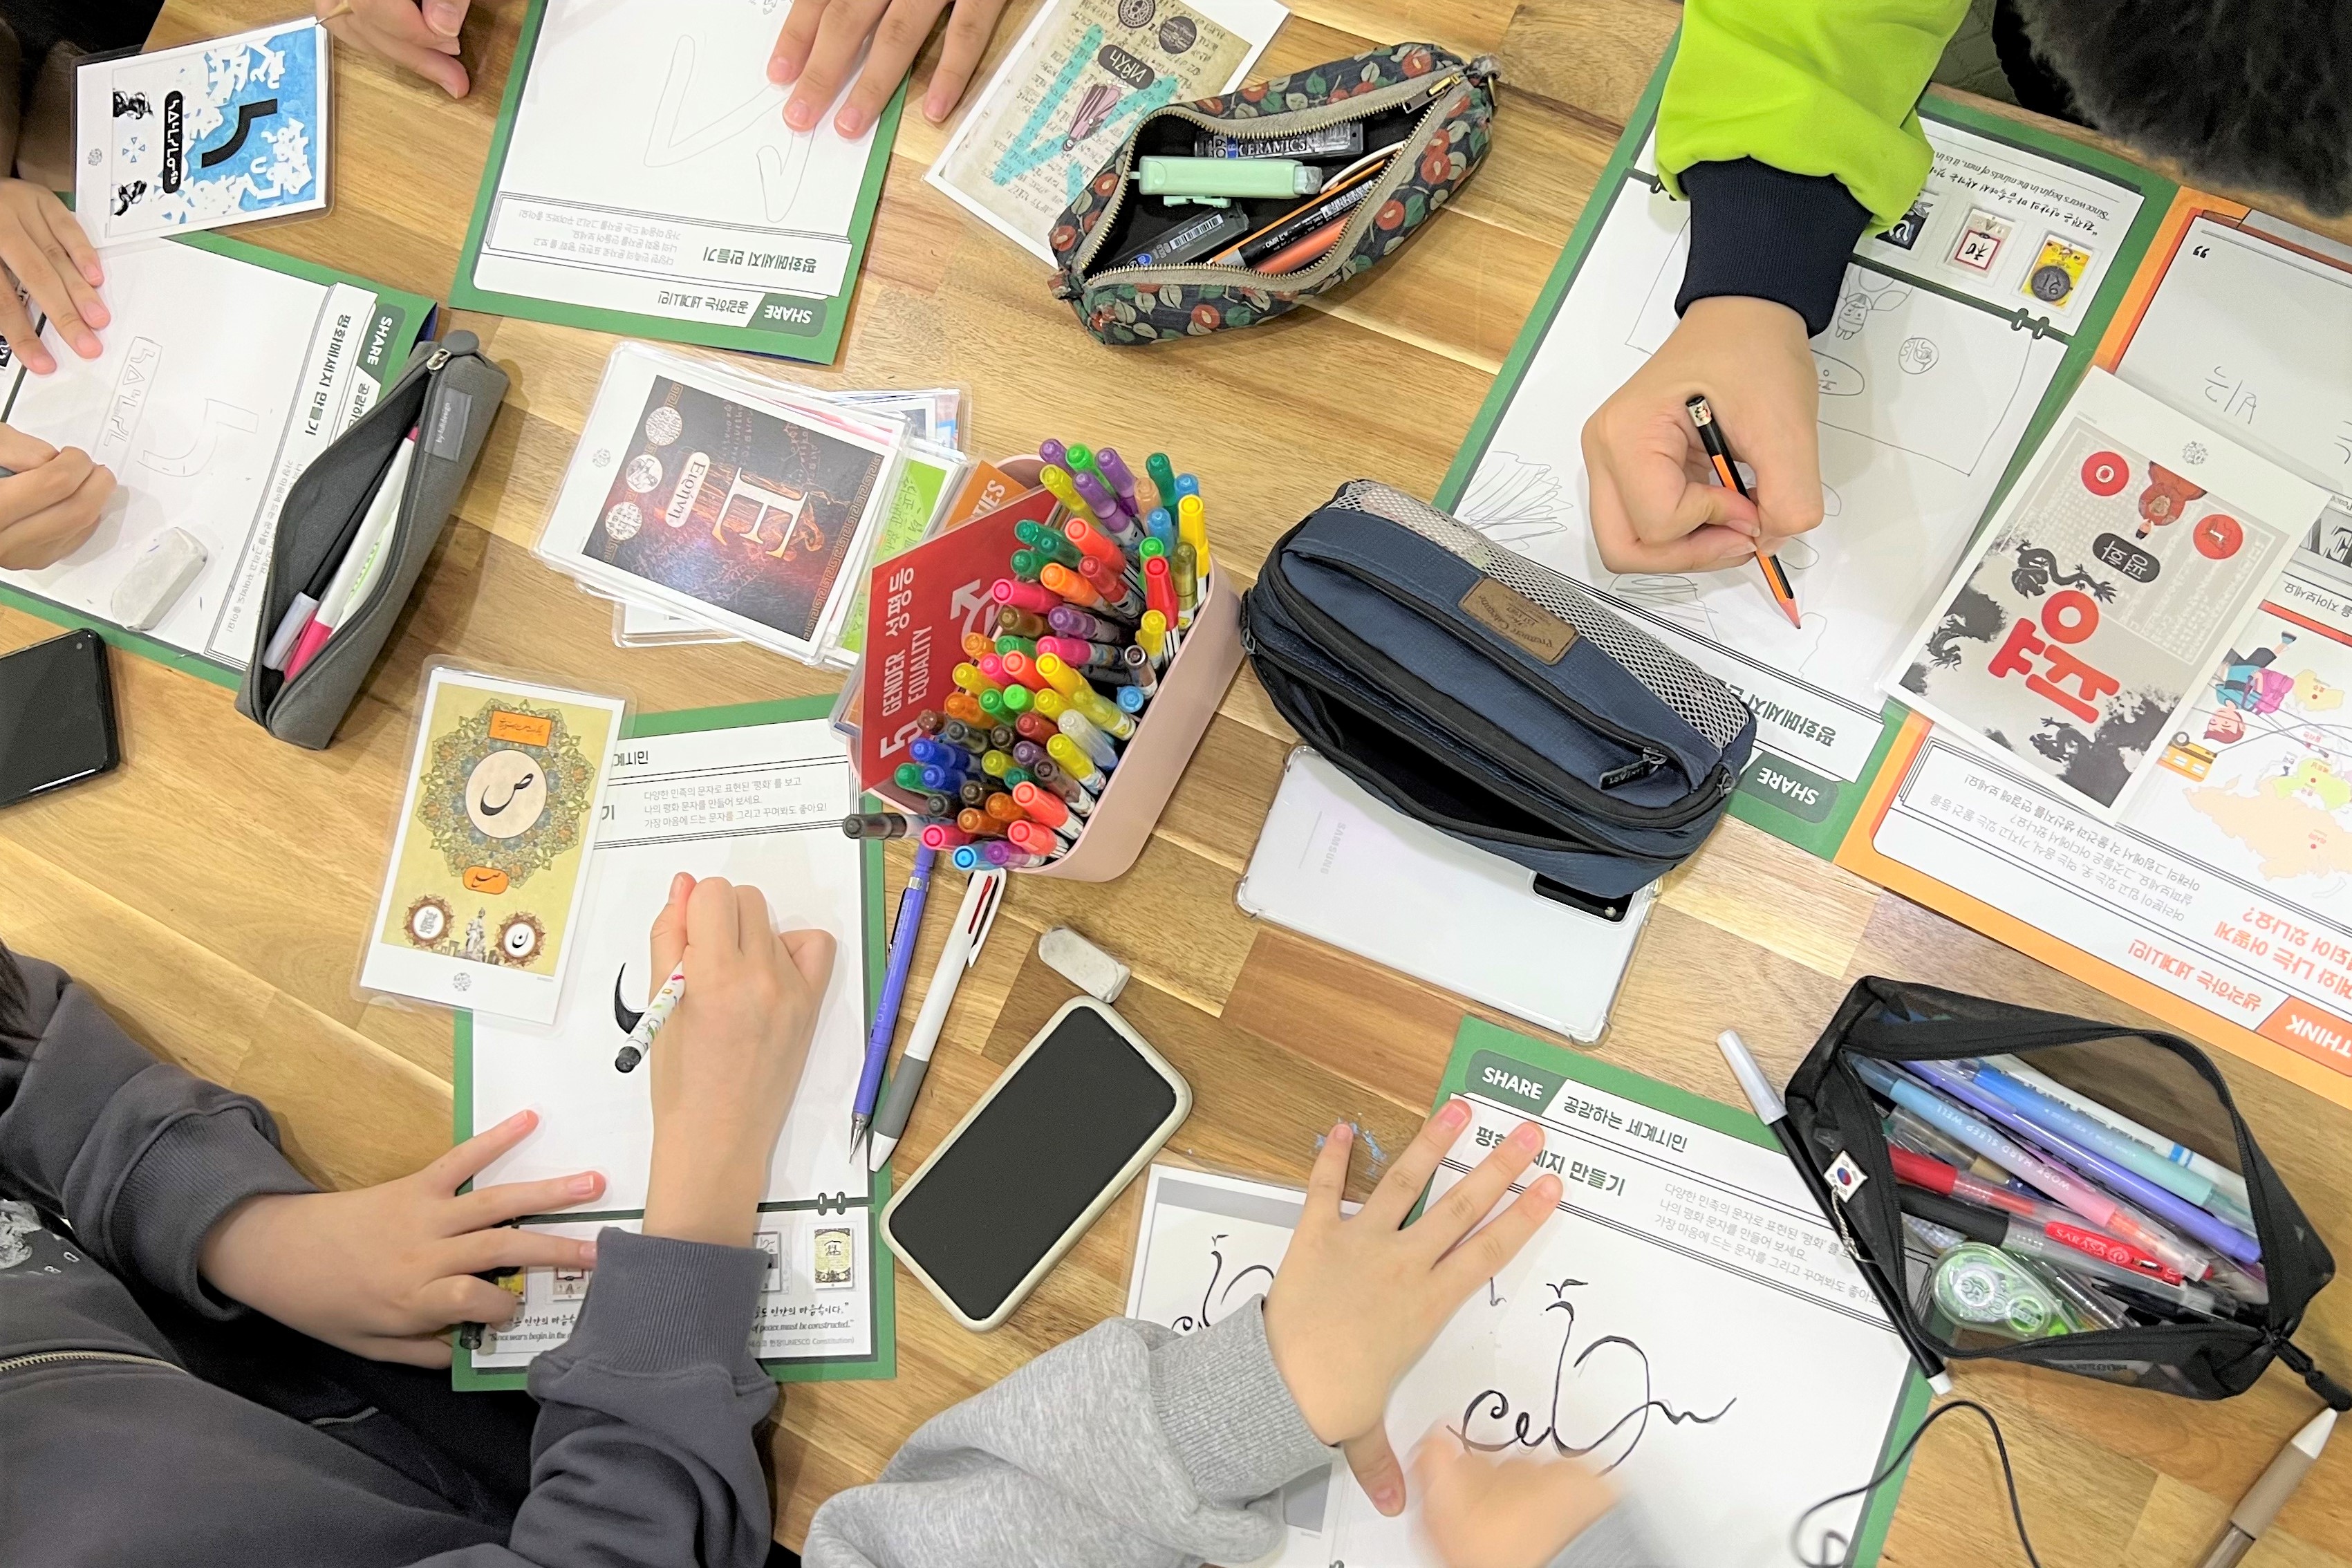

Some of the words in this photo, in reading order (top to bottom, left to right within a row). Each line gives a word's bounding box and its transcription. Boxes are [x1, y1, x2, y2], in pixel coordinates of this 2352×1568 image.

[702, 245, 744, 266] 만들기
[657, 290, 702, 309] 세계시민
[704, 295, 749, 315] 공감하는
[763, 304, 813, 325] SHARE
[366, 315, 393, 366] SHARE
[975, 479, 1005, 519] TIES
[2101, 540, 2149, 579] 평화
[886, 567, 915, 637] 성평등
[908, 626, 932, 705] EQUALITY
[882, 649, 906, 718] GENDER
[613, 750, 648, 766] 계시민
[1755, 766, 1820, 806] SHARE
[2055, 852, 2080, 872] 먹는
[2094, 870, 2119, 890] 있는
[2117, 881, 2142, 901] 입고
[2140, 893, 2187, 922] 여러분이
[2212, 919, 2270, 958] 어떻게
[2240, 904, 2310, 948] 있나요?
[2127, 937, 2196, 982] 세계시민
[2269, 946, 2315, 980] 나는
[2309, 936, 2352, 971] 되어
[2193, 969, 2264, 1014] 생각하는
[2315, 967, 2352, 999] 계와
[2284, 1012, 2352, 1058] THINK
[1480, 1065, 1544, 1101] SHARE
[1562, 1095, 1625, 1130] 공감하는
[1623, 1117, 1689, 1153] 세계시민
[1934, 1103, 1965, 1126] WELL
[1964, 1121, 1999, 1148] SLEEP
[2000, 1143, 2033, 1167] HARD
[1567, 1161, 1627, 1197] 만들기
[2037, 1166, 2071, 1191] WORK
[1846, 1284, 1883, 1307] 좋아요
